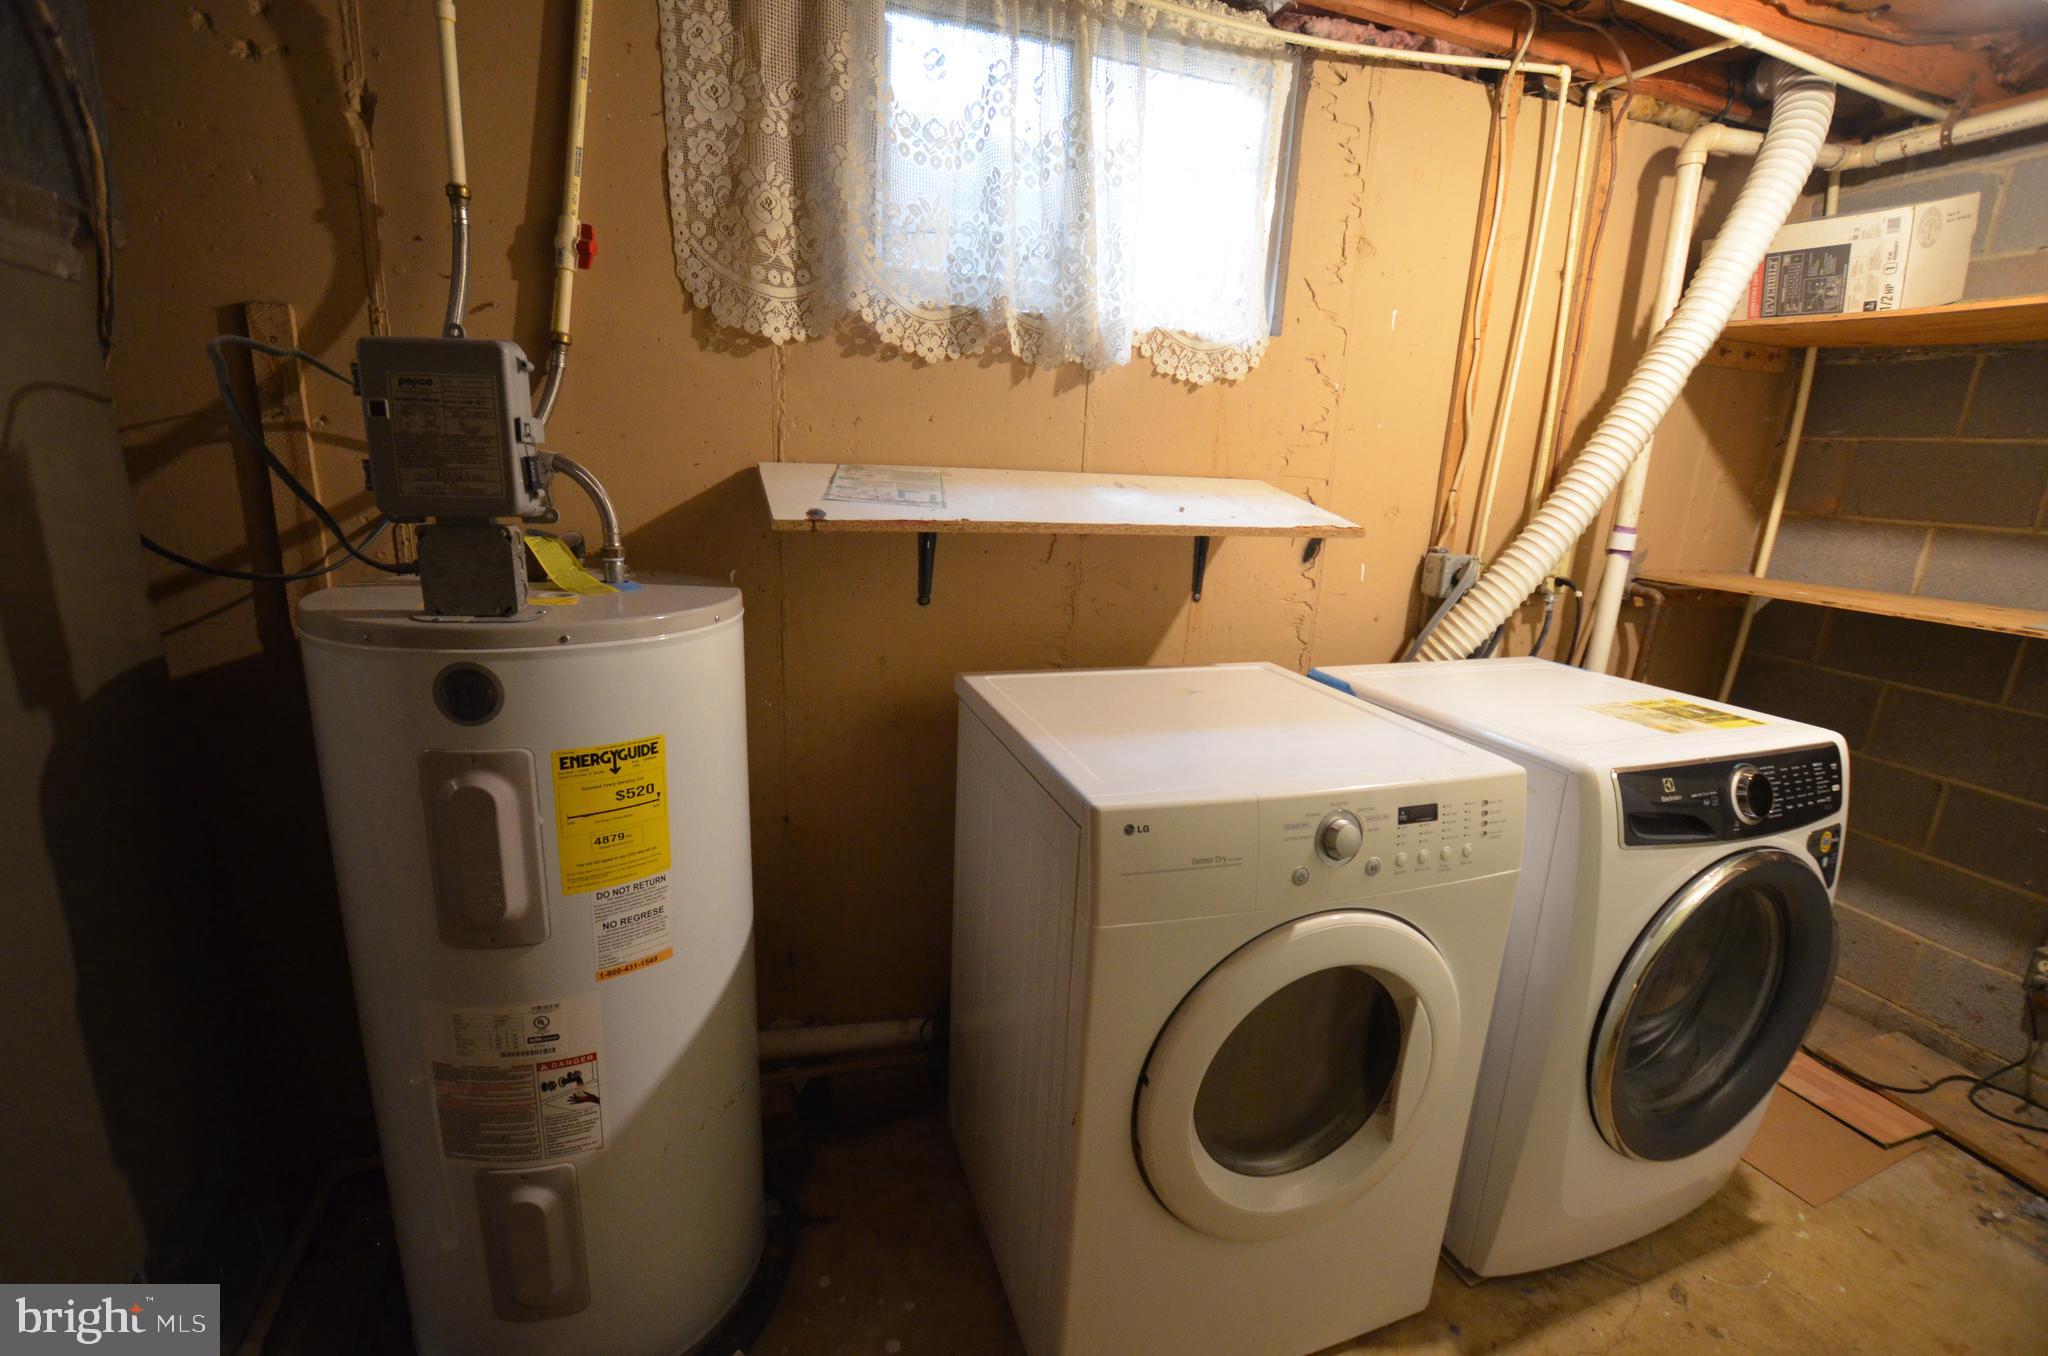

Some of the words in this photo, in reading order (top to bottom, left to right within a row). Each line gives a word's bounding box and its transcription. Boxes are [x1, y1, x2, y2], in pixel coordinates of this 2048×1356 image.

[1765, 258, 1780, 314] EVERBILT
[1884, 283, 1895, 295] HP
[1879, 295, 1894, 311] 1/2
[398, 377, 433, 388] pepco
[615, 783, 655, 802] $520
[1137, 825, 1150, 834] LG
[594, 832, 625, 846] 4879
[596, 890, 610, 901] DO
[612, 885, 630, 897] NOT
[633, 875, 667, 891] RETURN
[602, 920, 617, 931] NO
[620, 905, 665, 926] REGRESE
[551, 1053, 594, 1068] DANGER
